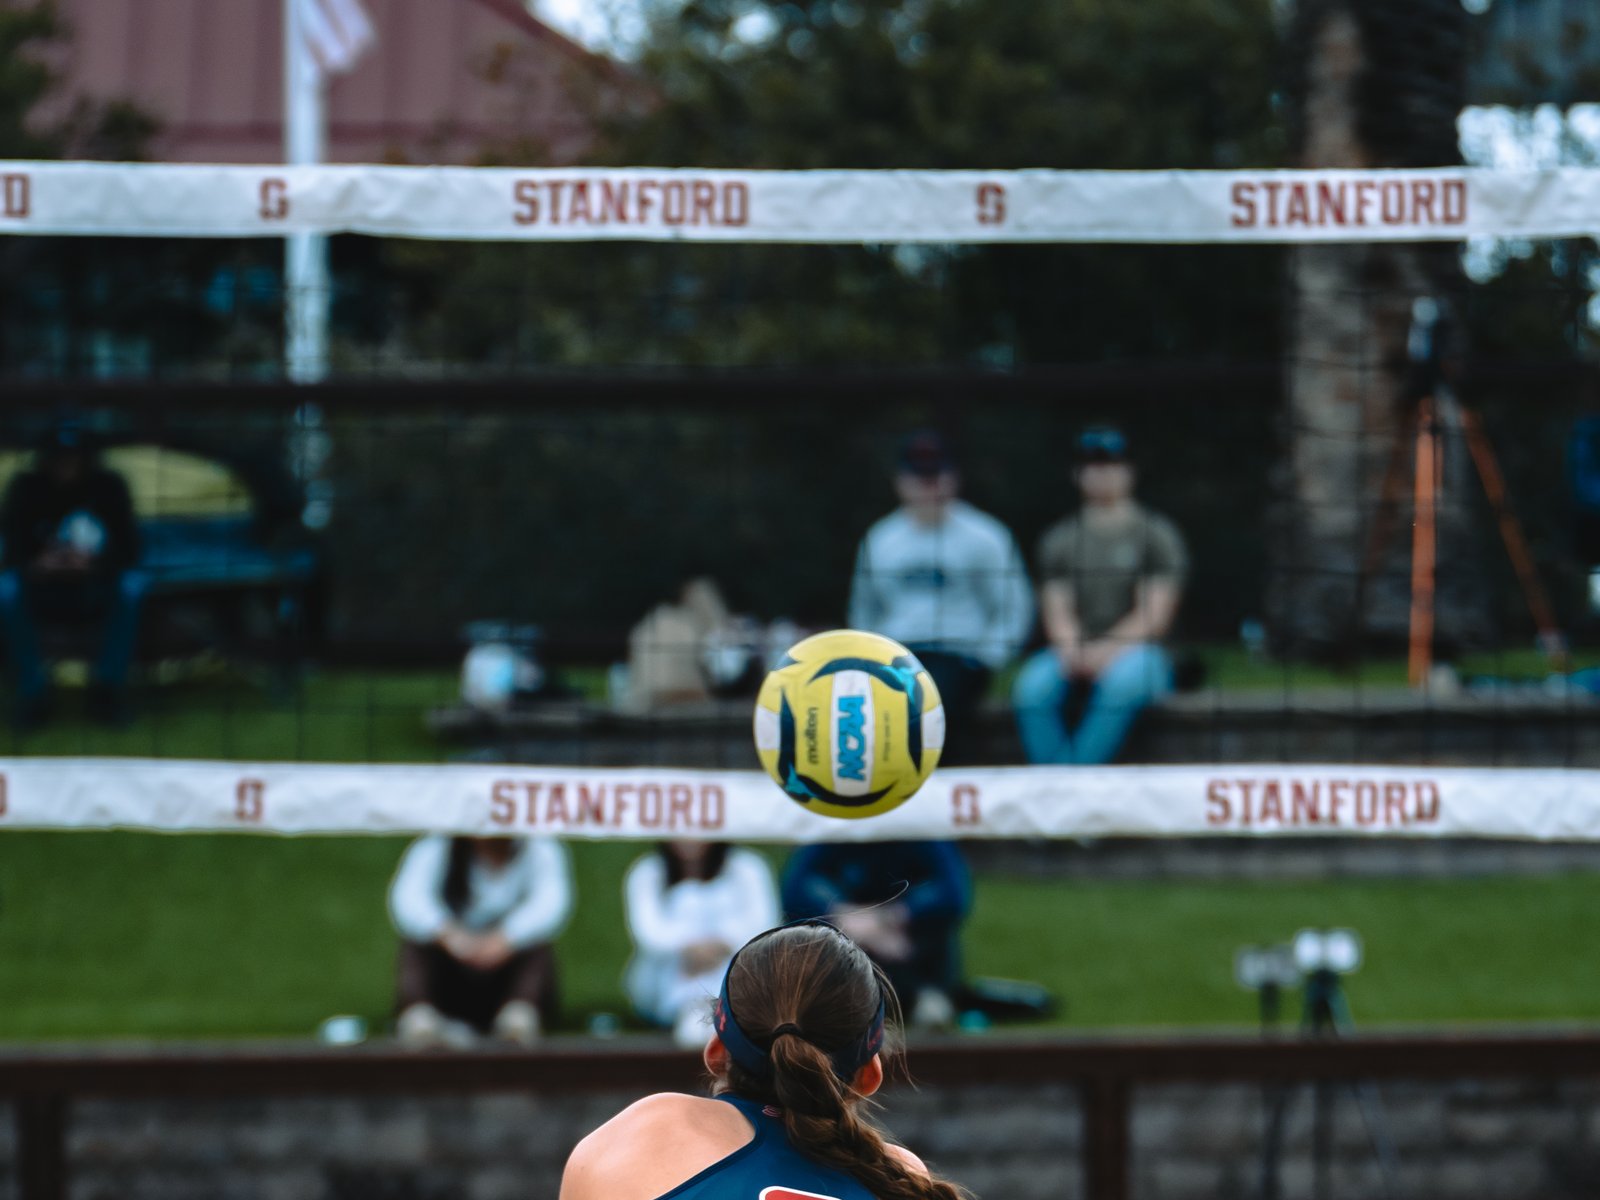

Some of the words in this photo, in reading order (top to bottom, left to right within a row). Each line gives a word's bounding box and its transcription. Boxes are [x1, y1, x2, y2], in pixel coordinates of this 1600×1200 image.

[513, 179, 748, 226] STANFORD
[1230, 178, 1467, 228] STANFORD
[837, 694, 866, 782] NCAA
[490, 780, 726, 829] STANFORD
[1205, 778, 1442, 827] STANFORD
